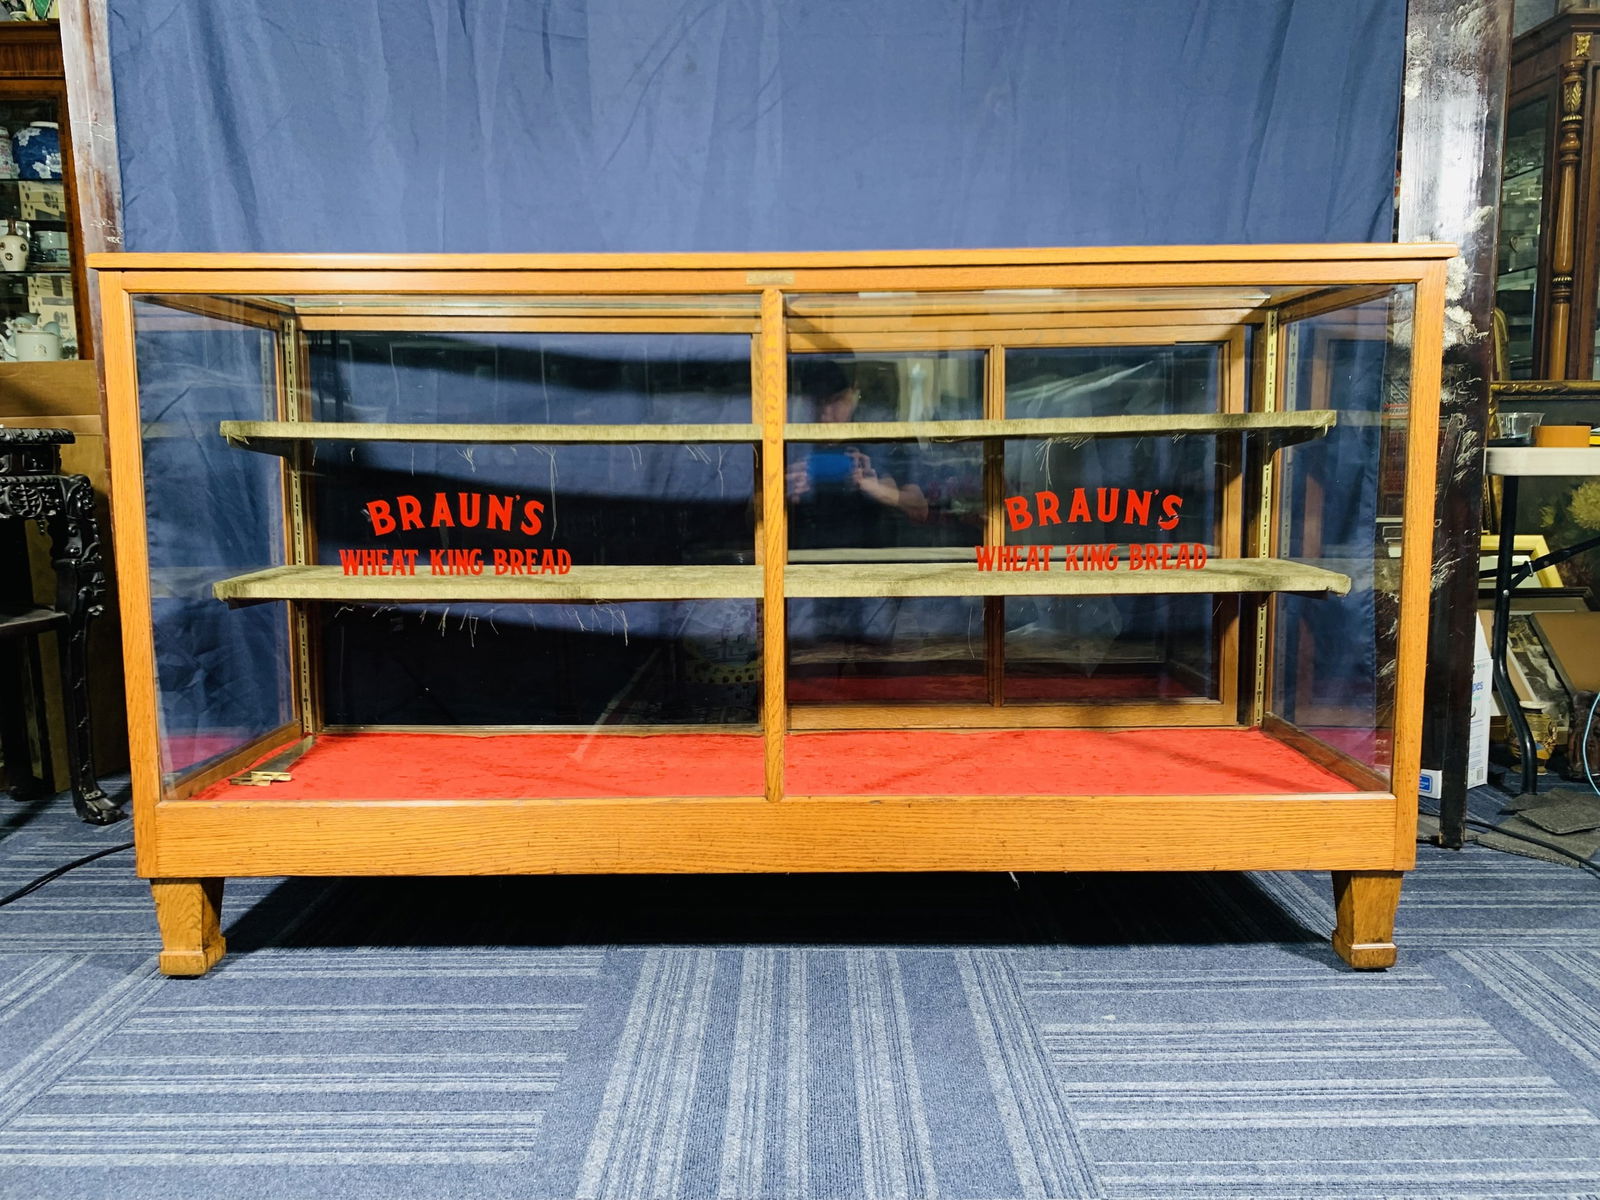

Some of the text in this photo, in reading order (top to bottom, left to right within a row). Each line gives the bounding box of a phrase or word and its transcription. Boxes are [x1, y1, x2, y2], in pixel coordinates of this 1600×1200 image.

[367, 492, 545, 536] BRAUN'S
[1004, 487, 1183, 531] BRAUN'S
[339, 549, 572, 576] WHEAT KING BREAD
[975, 544, 1207, 572] WHEAT KING BREAD
